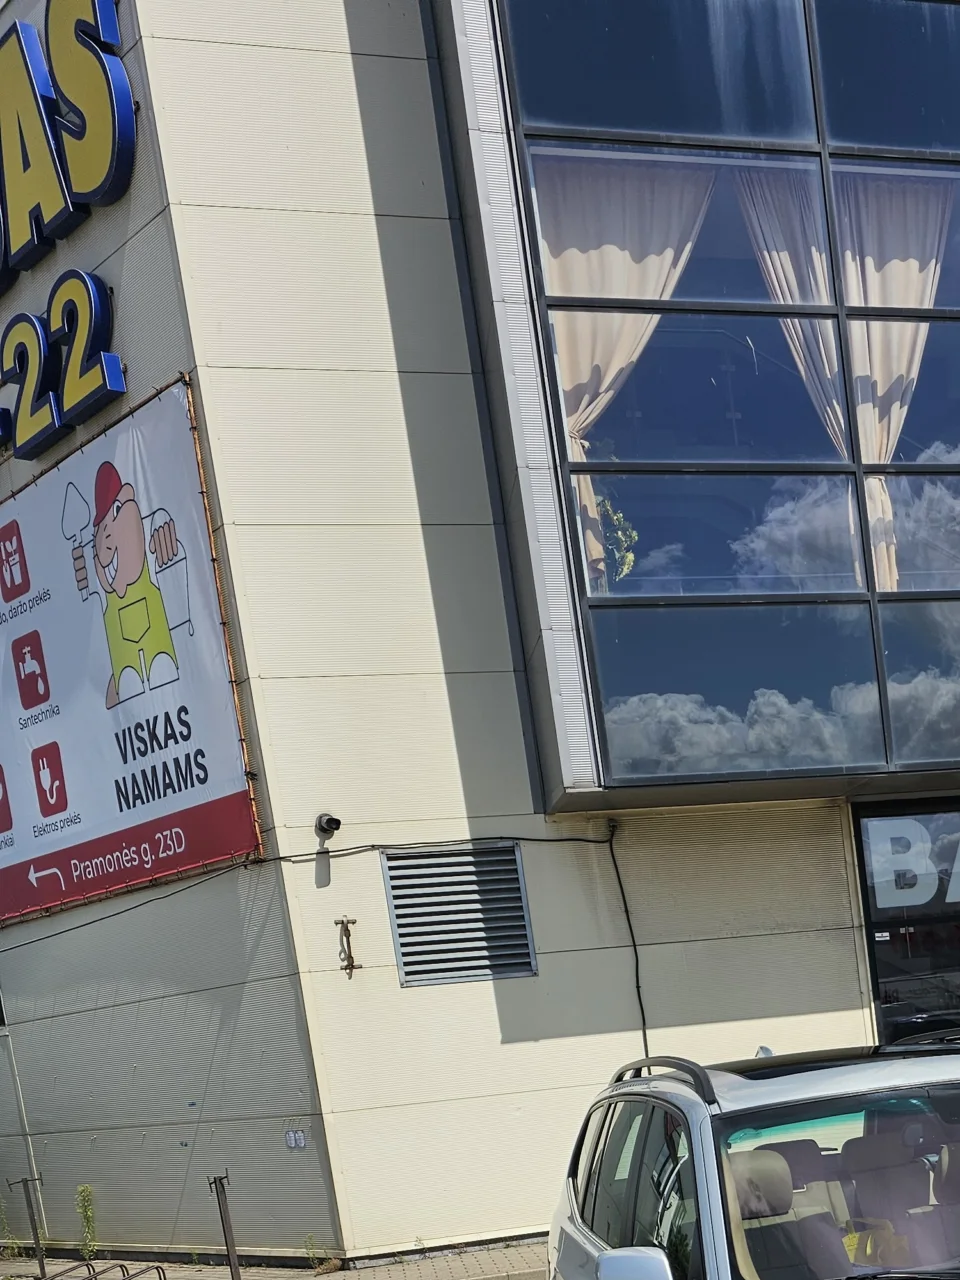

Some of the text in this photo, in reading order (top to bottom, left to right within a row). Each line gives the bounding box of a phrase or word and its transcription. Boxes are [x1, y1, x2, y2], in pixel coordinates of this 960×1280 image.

[0, 0, 122, 268] AS
[8, 600, 28, 620] daržo
[28, 587, 52, 613] prekės
[18, 702, 61, 731] Santechnika
[114, 704, 192, 765] VISKAS
[114, 748, 209, 813] NAMAMS
[33, 811, 82, 838] Elektros prekės
[71, 827, 186, 883] Pramonės g. 23D
